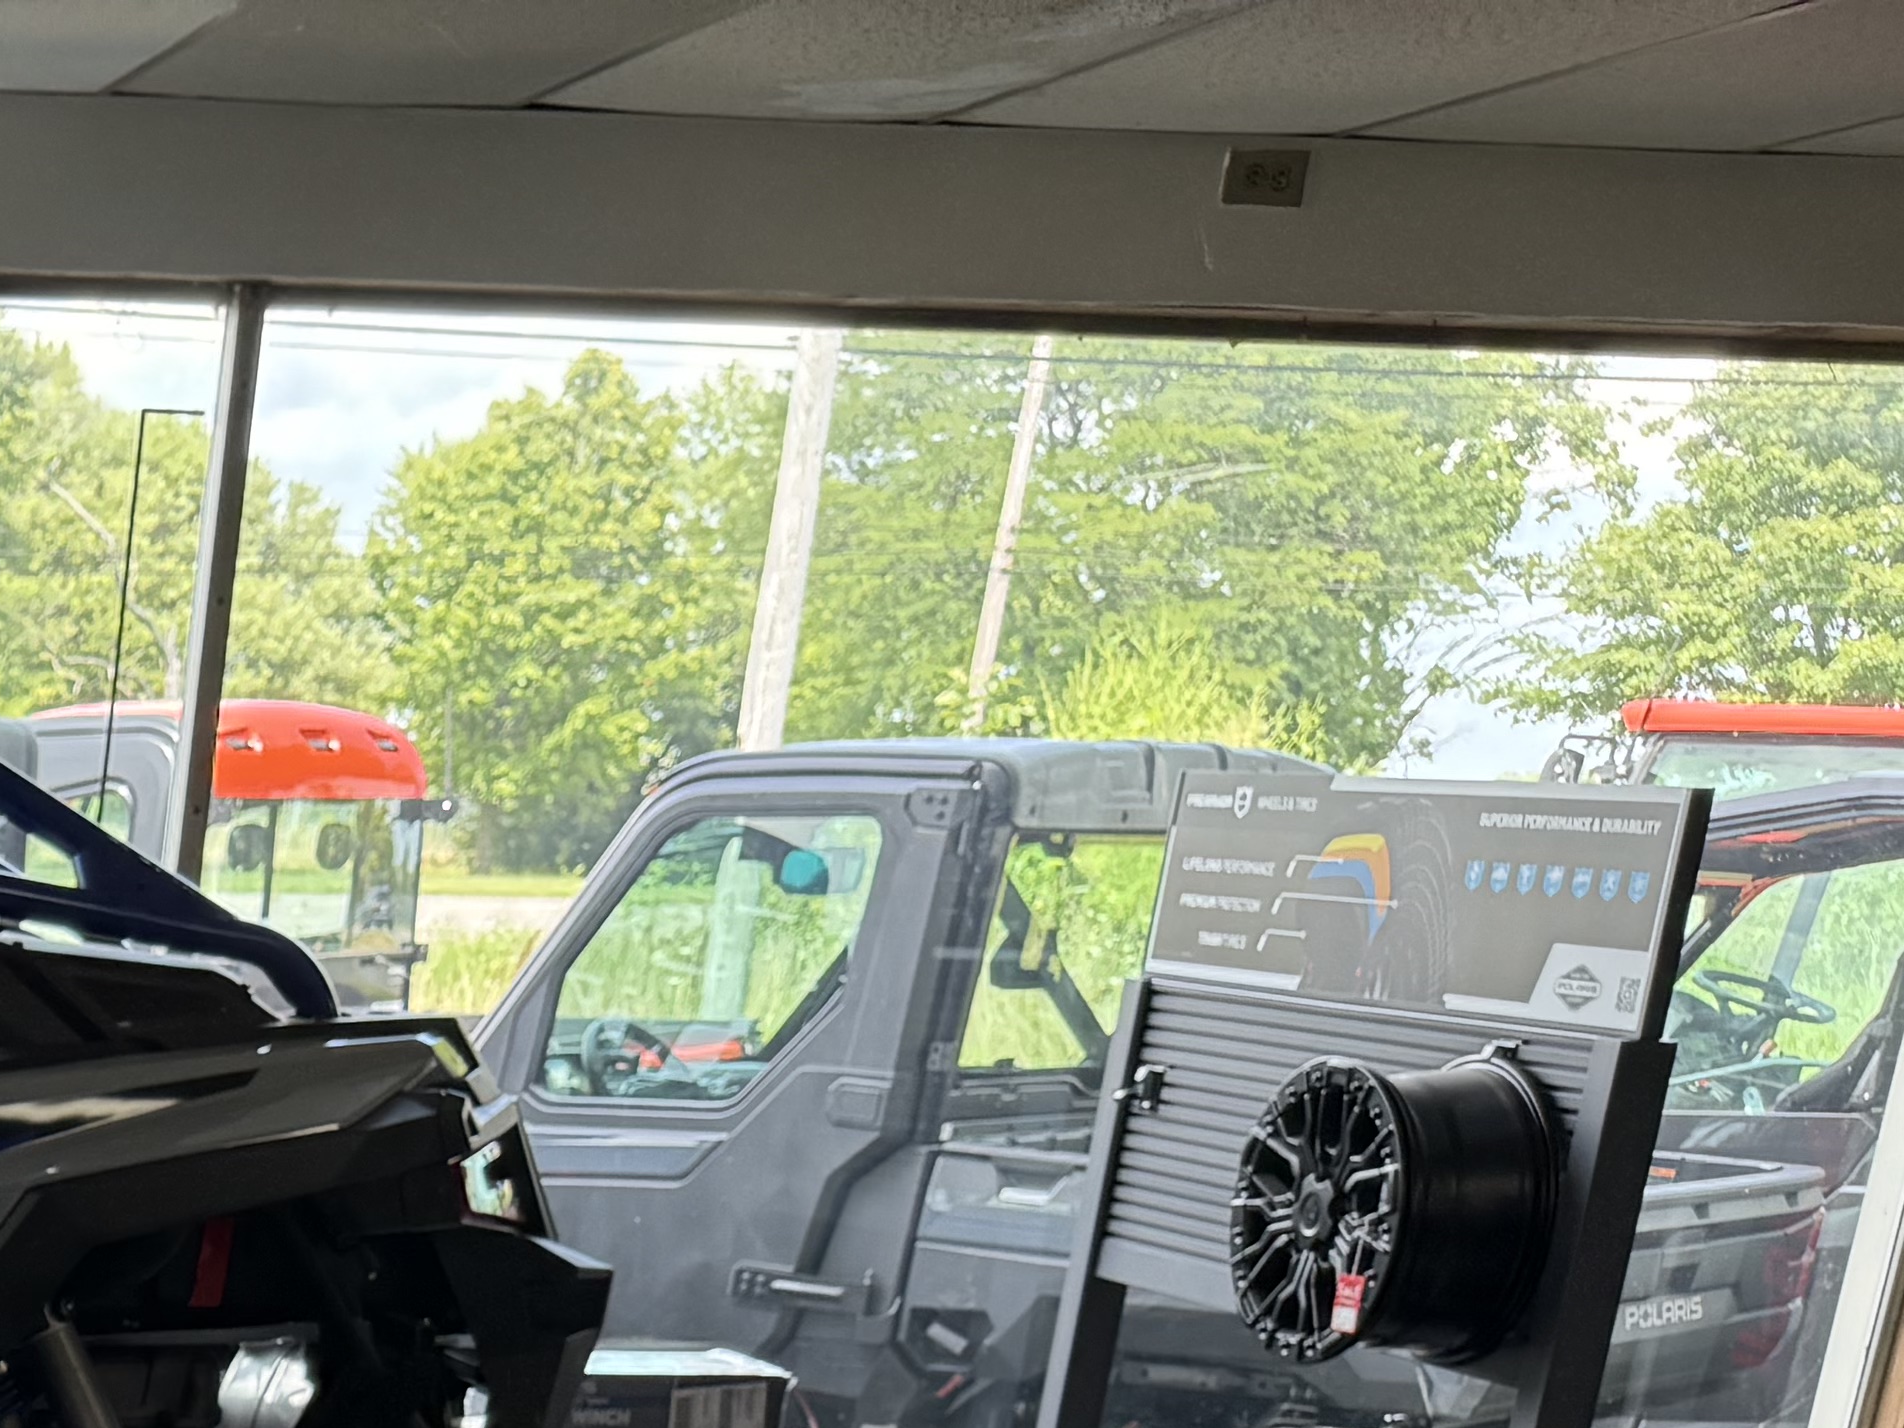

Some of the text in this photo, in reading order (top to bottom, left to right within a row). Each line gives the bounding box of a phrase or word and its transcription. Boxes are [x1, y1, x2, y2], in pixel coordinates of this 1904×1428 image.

[1524, 814, 1592, 832] PERFORMANCE
[1601, 817, 1662, 836] DURABILITY
[1624, 1295, 1703, 1331] POLARIS
